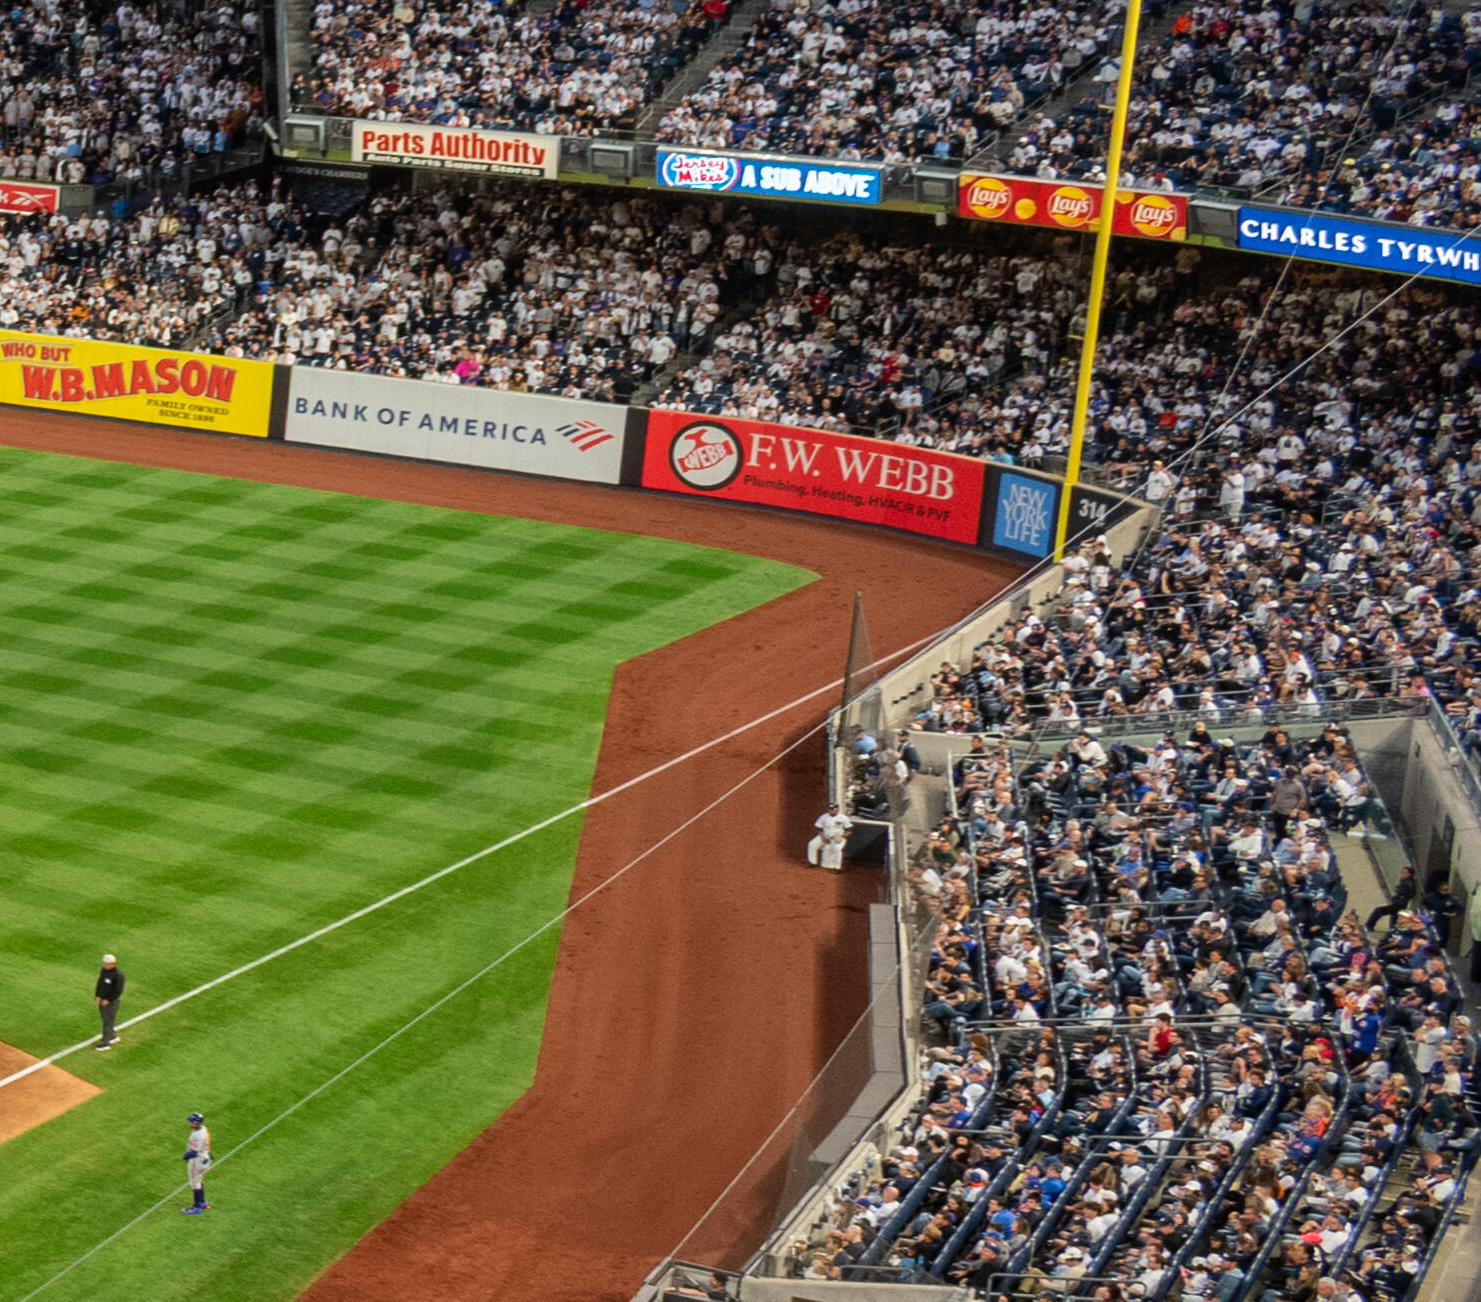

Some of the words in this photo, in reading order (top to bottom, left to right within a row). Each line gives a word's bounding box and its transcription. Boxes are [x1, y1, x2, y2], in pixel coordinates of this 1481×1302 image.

[362, 130, 424, 155] Parts
[430, 131, 546, 165] Authority
[1240, 219, 1366, 253] CHARLES
[0, 341, 37, 362] WHO
[40, 344, 71, 363] BUT
[21, 357, 238, 403] W.B.MASON
[146, 399, 186, 409] FAMILY
[188, 404, 229, 415] OWNED
[295, 397, 368, 422] BANK
[377, 406, 412, 426] OF
[419, 410, 547, 446] AMERICA
[746, 432, 821, 477] F.W.
[835, 446, 955, 501] WEBB
